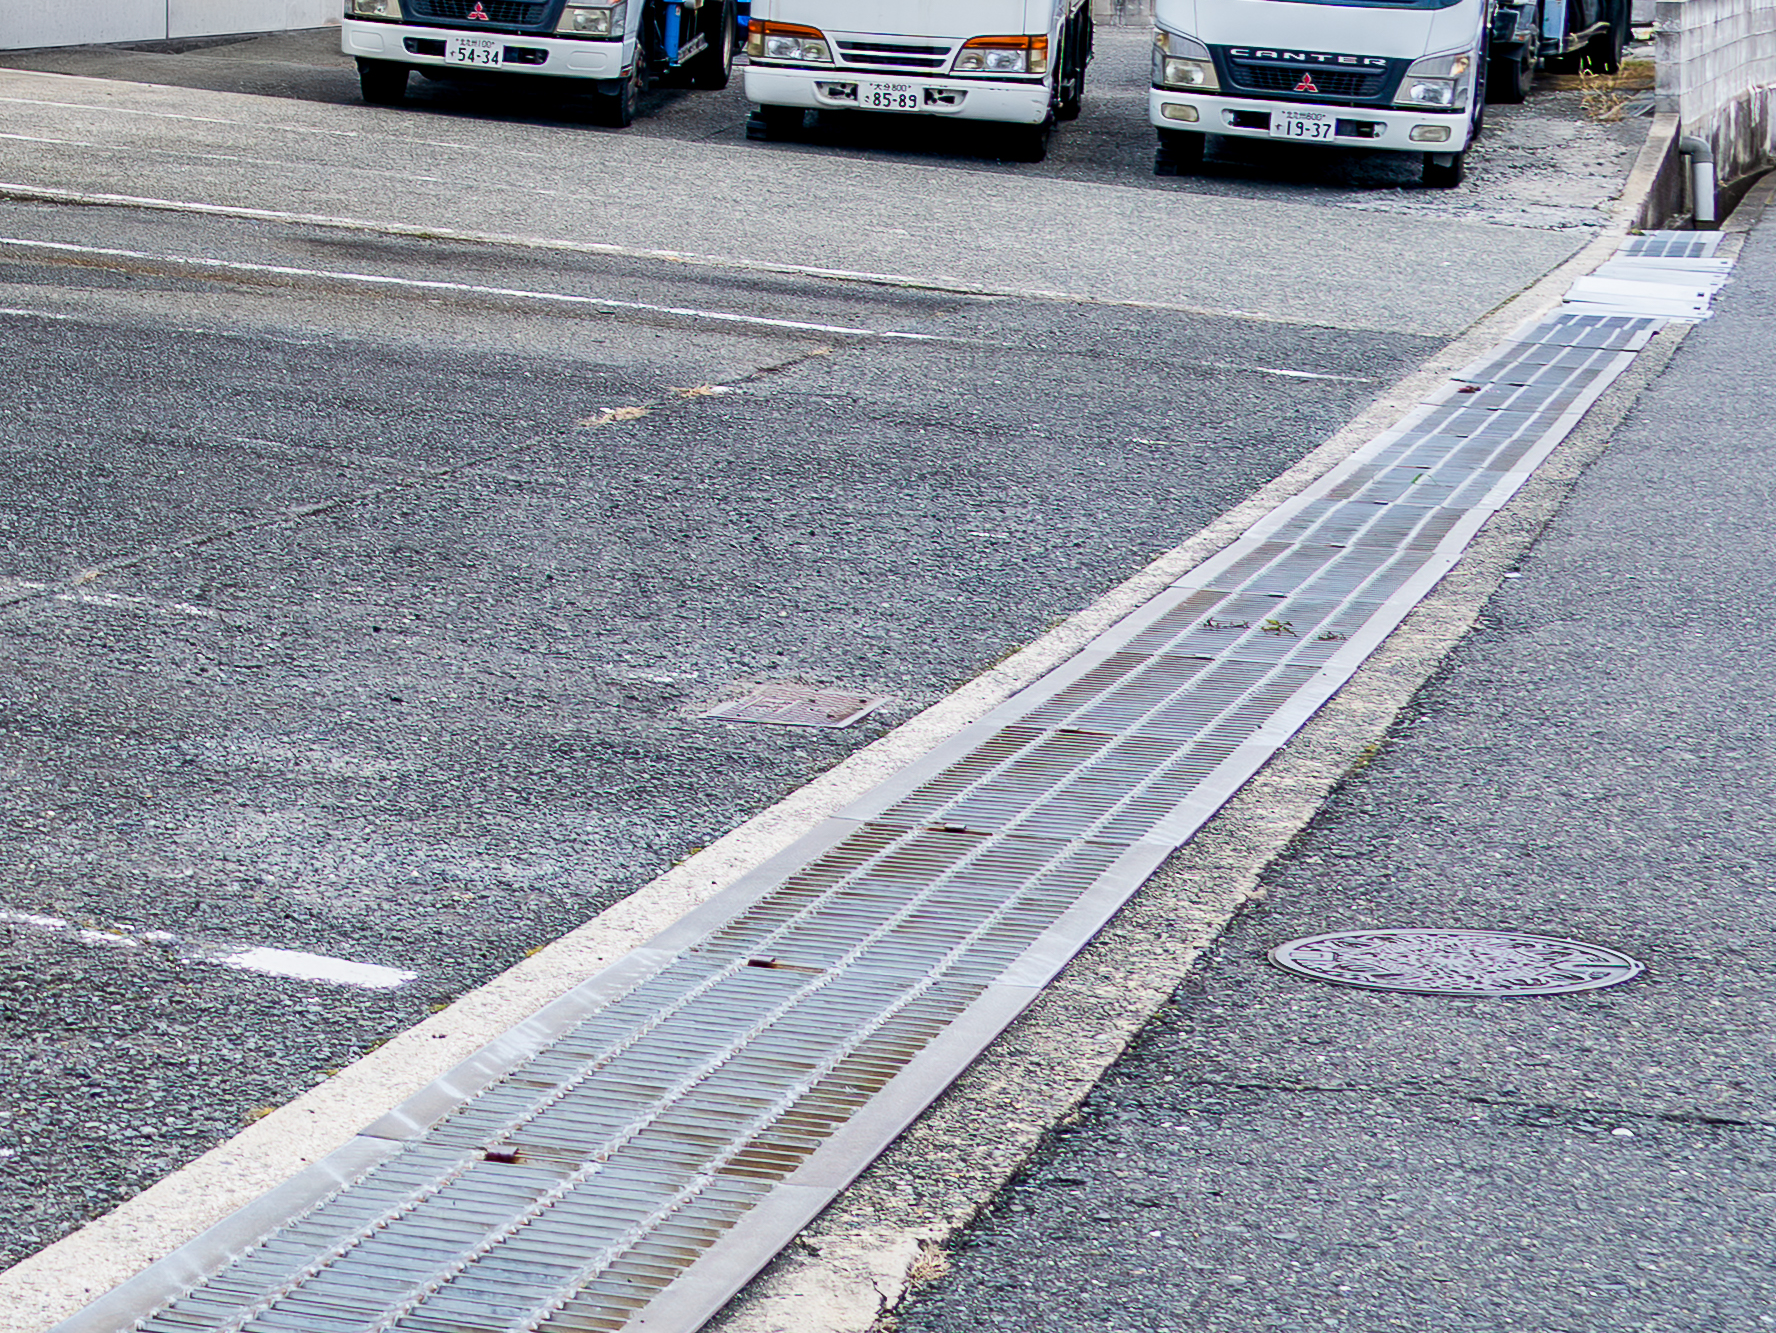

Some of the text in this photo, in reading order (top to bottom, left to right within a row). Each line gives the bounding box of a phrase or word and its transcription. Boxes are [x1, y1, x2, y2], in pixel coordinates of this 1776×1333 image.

[458, 47, 499, 65] 54-34
[1230, 48, 1386, 66] CANTER
[873, 92, 917, 108] 85-89
[1286, 120, 1332, 139] 19-37
